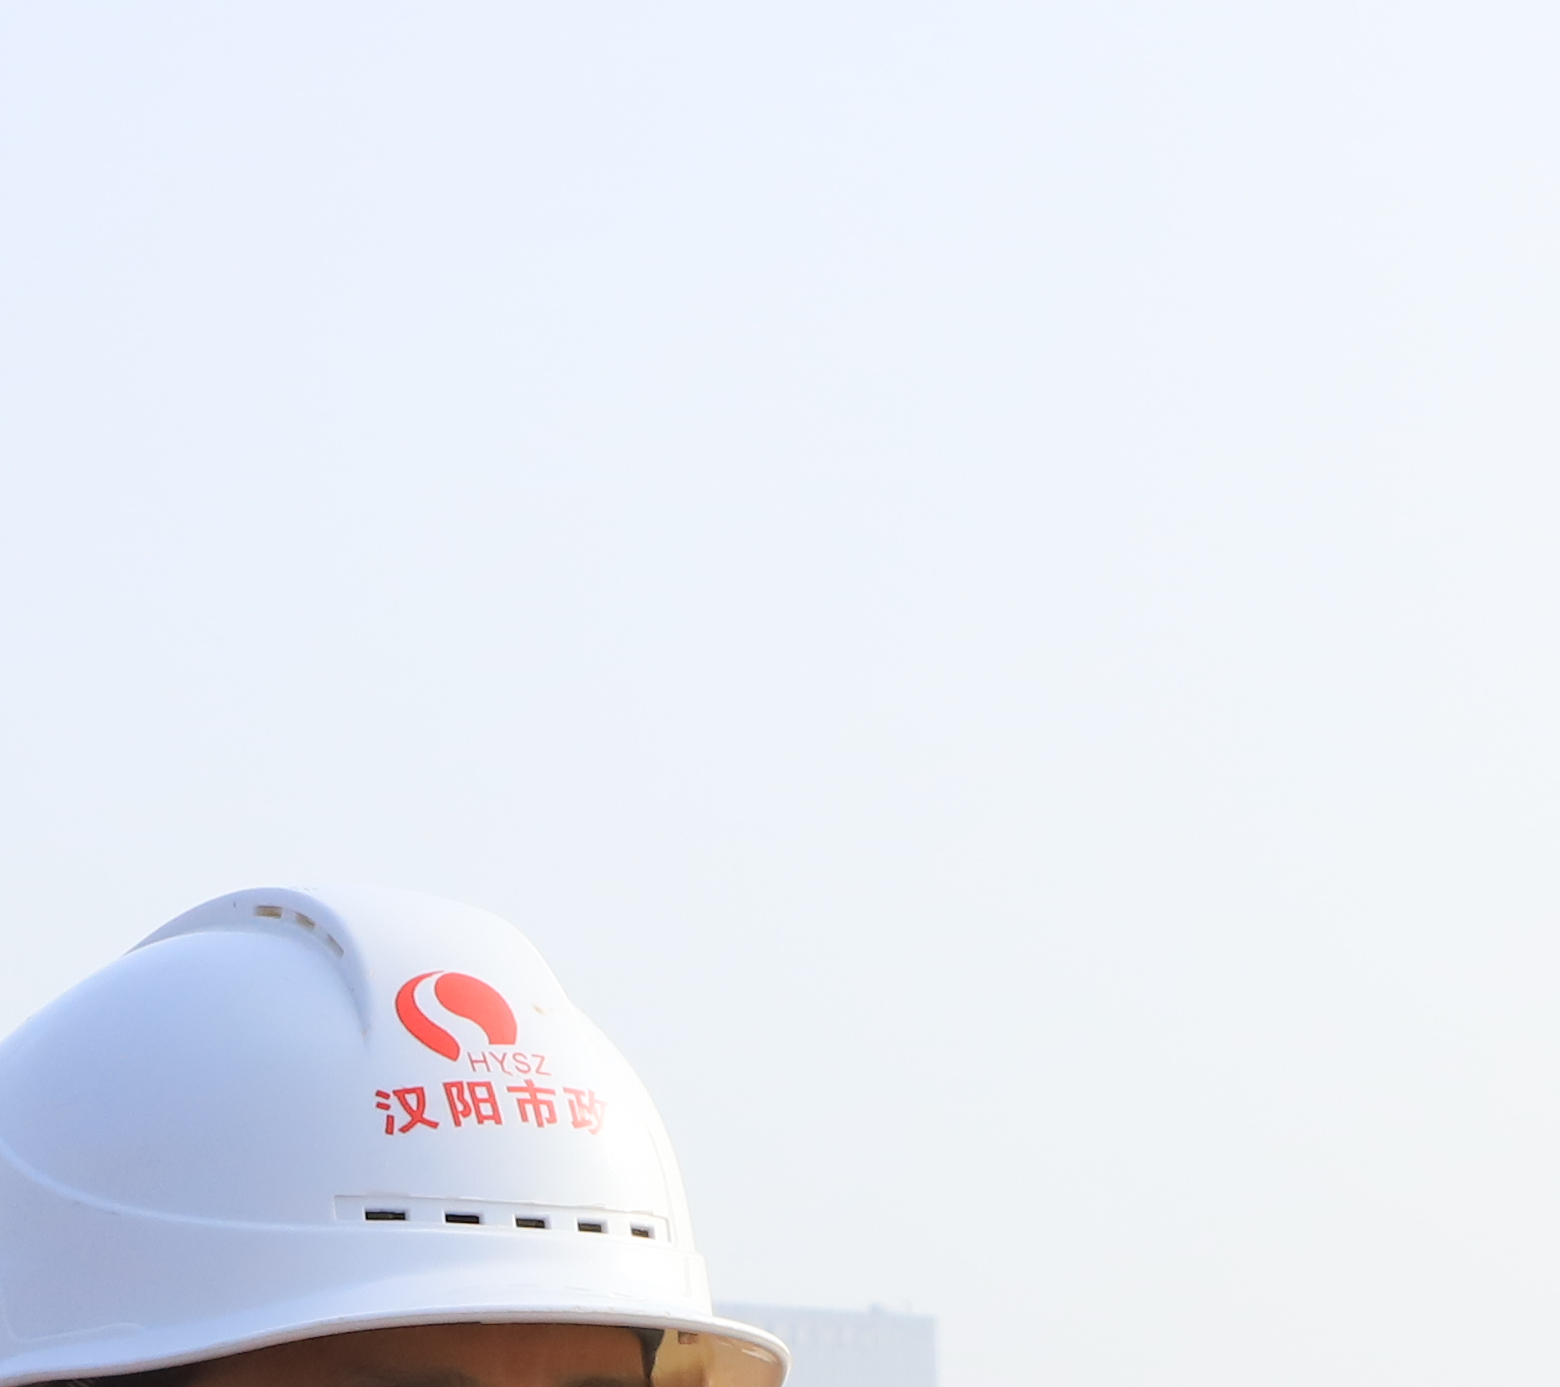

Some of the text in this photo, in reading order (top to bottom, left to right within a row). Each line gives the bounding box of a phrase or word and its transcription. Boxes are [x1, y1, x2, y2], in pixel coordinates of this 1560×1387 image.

[467, 1051, 552, 1077] HYSZ
[374, 1078, 609, 1136] 汉阳市政
